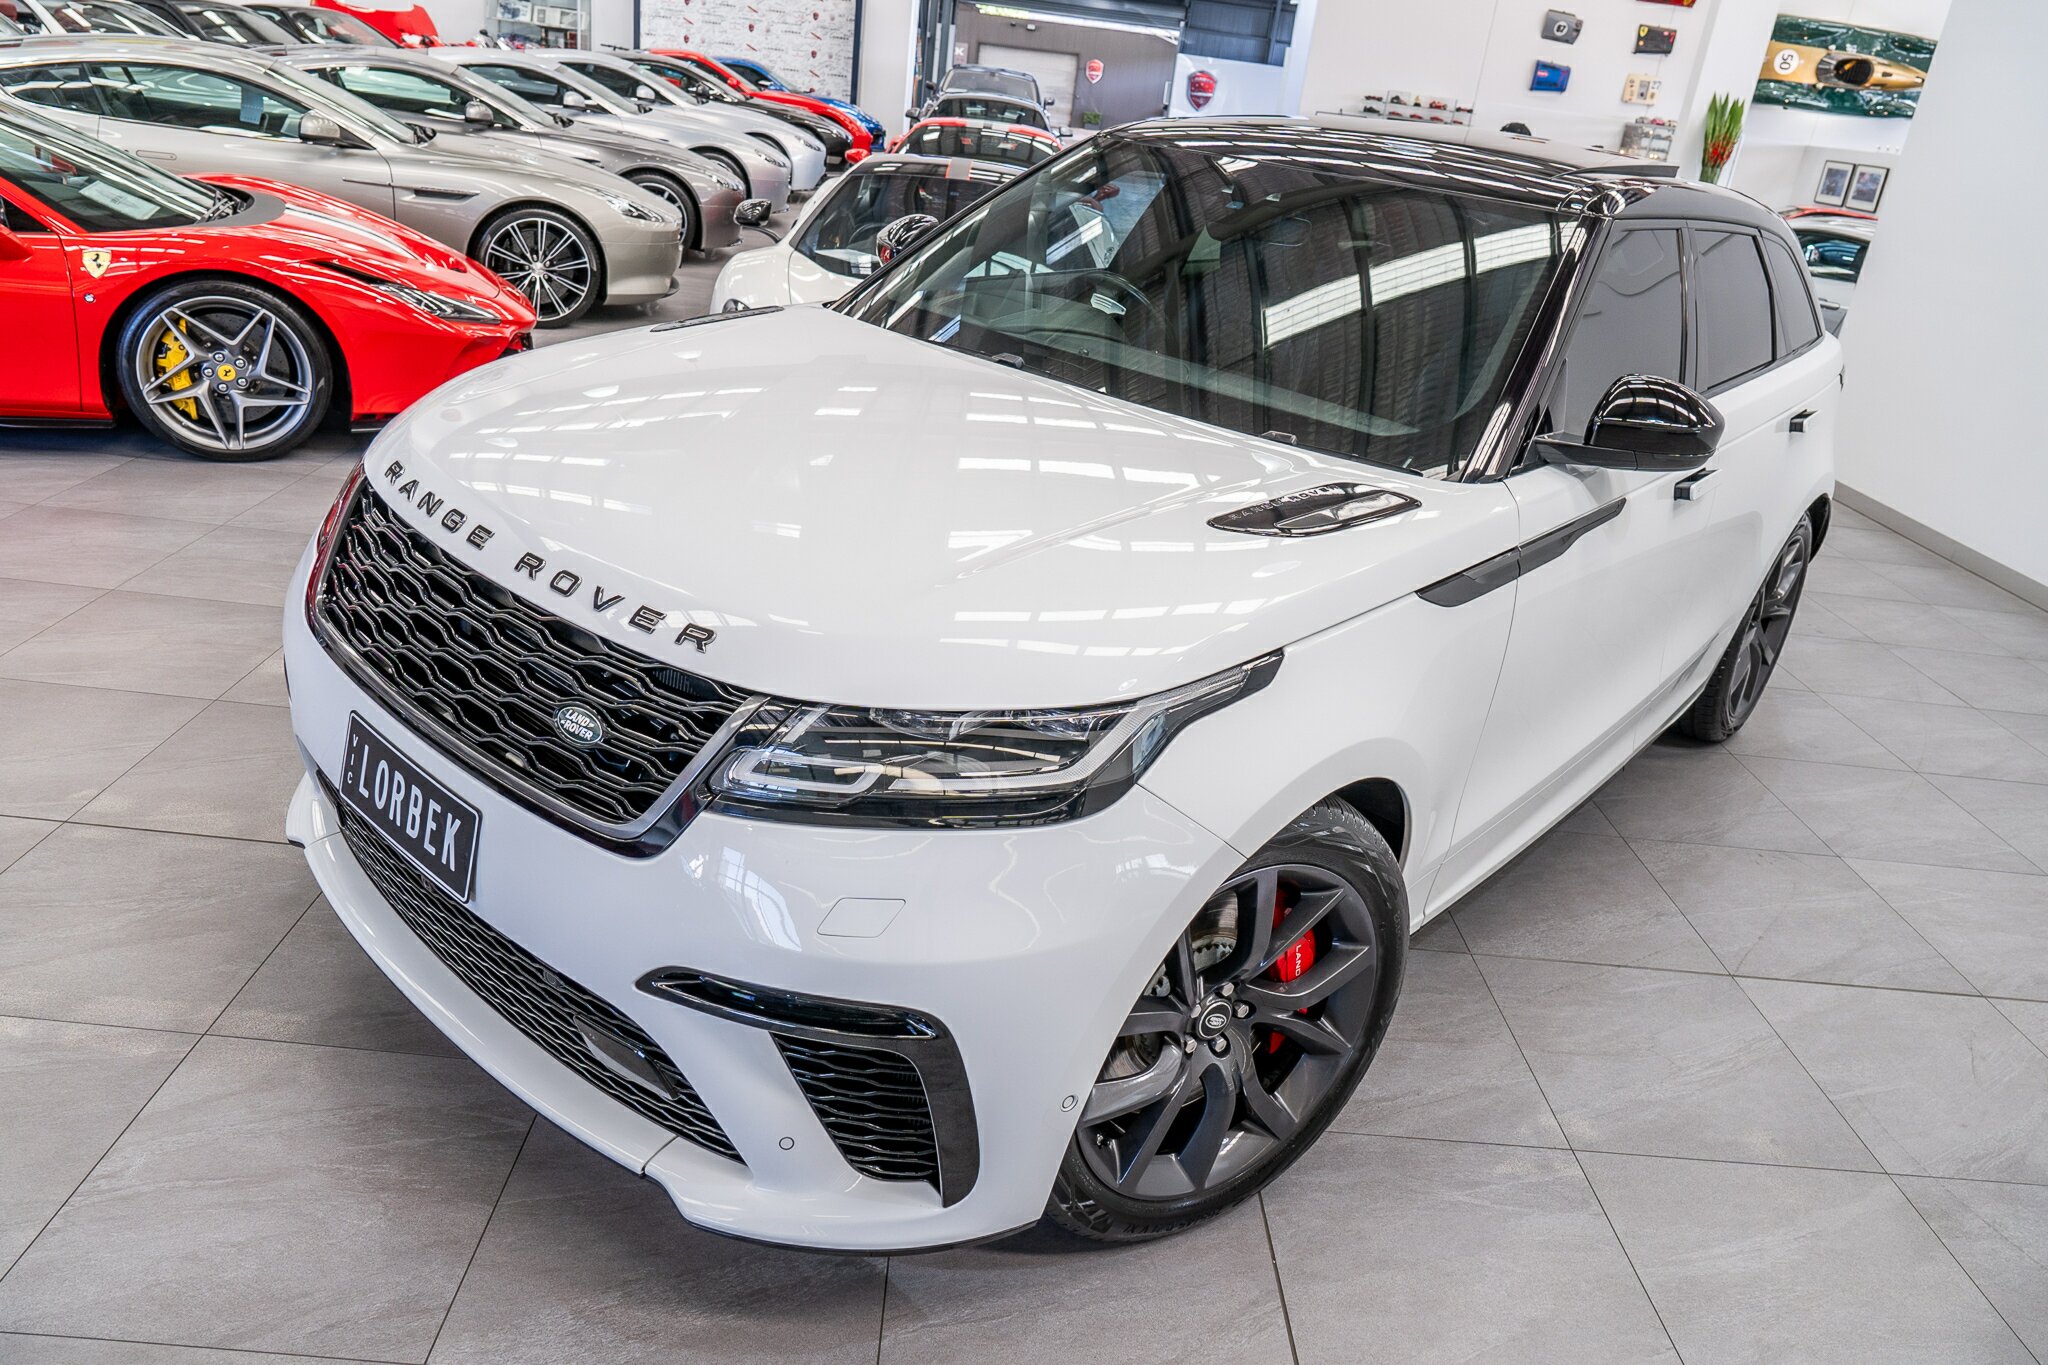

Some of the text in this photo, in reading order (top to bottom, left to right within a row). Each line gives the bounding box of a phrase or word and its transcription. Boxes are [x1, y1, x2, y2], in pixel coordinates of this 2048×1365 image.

[1780, 53, 1794, 70] 50
[384, 460, 718, 654] RANGE ROVER
[563, 719, 594, 740] ROVER
[565, 709, 591, 727] LAND
[347, 734, 358, 784] VIC
[358, 744, 462, 872] LORBEK
